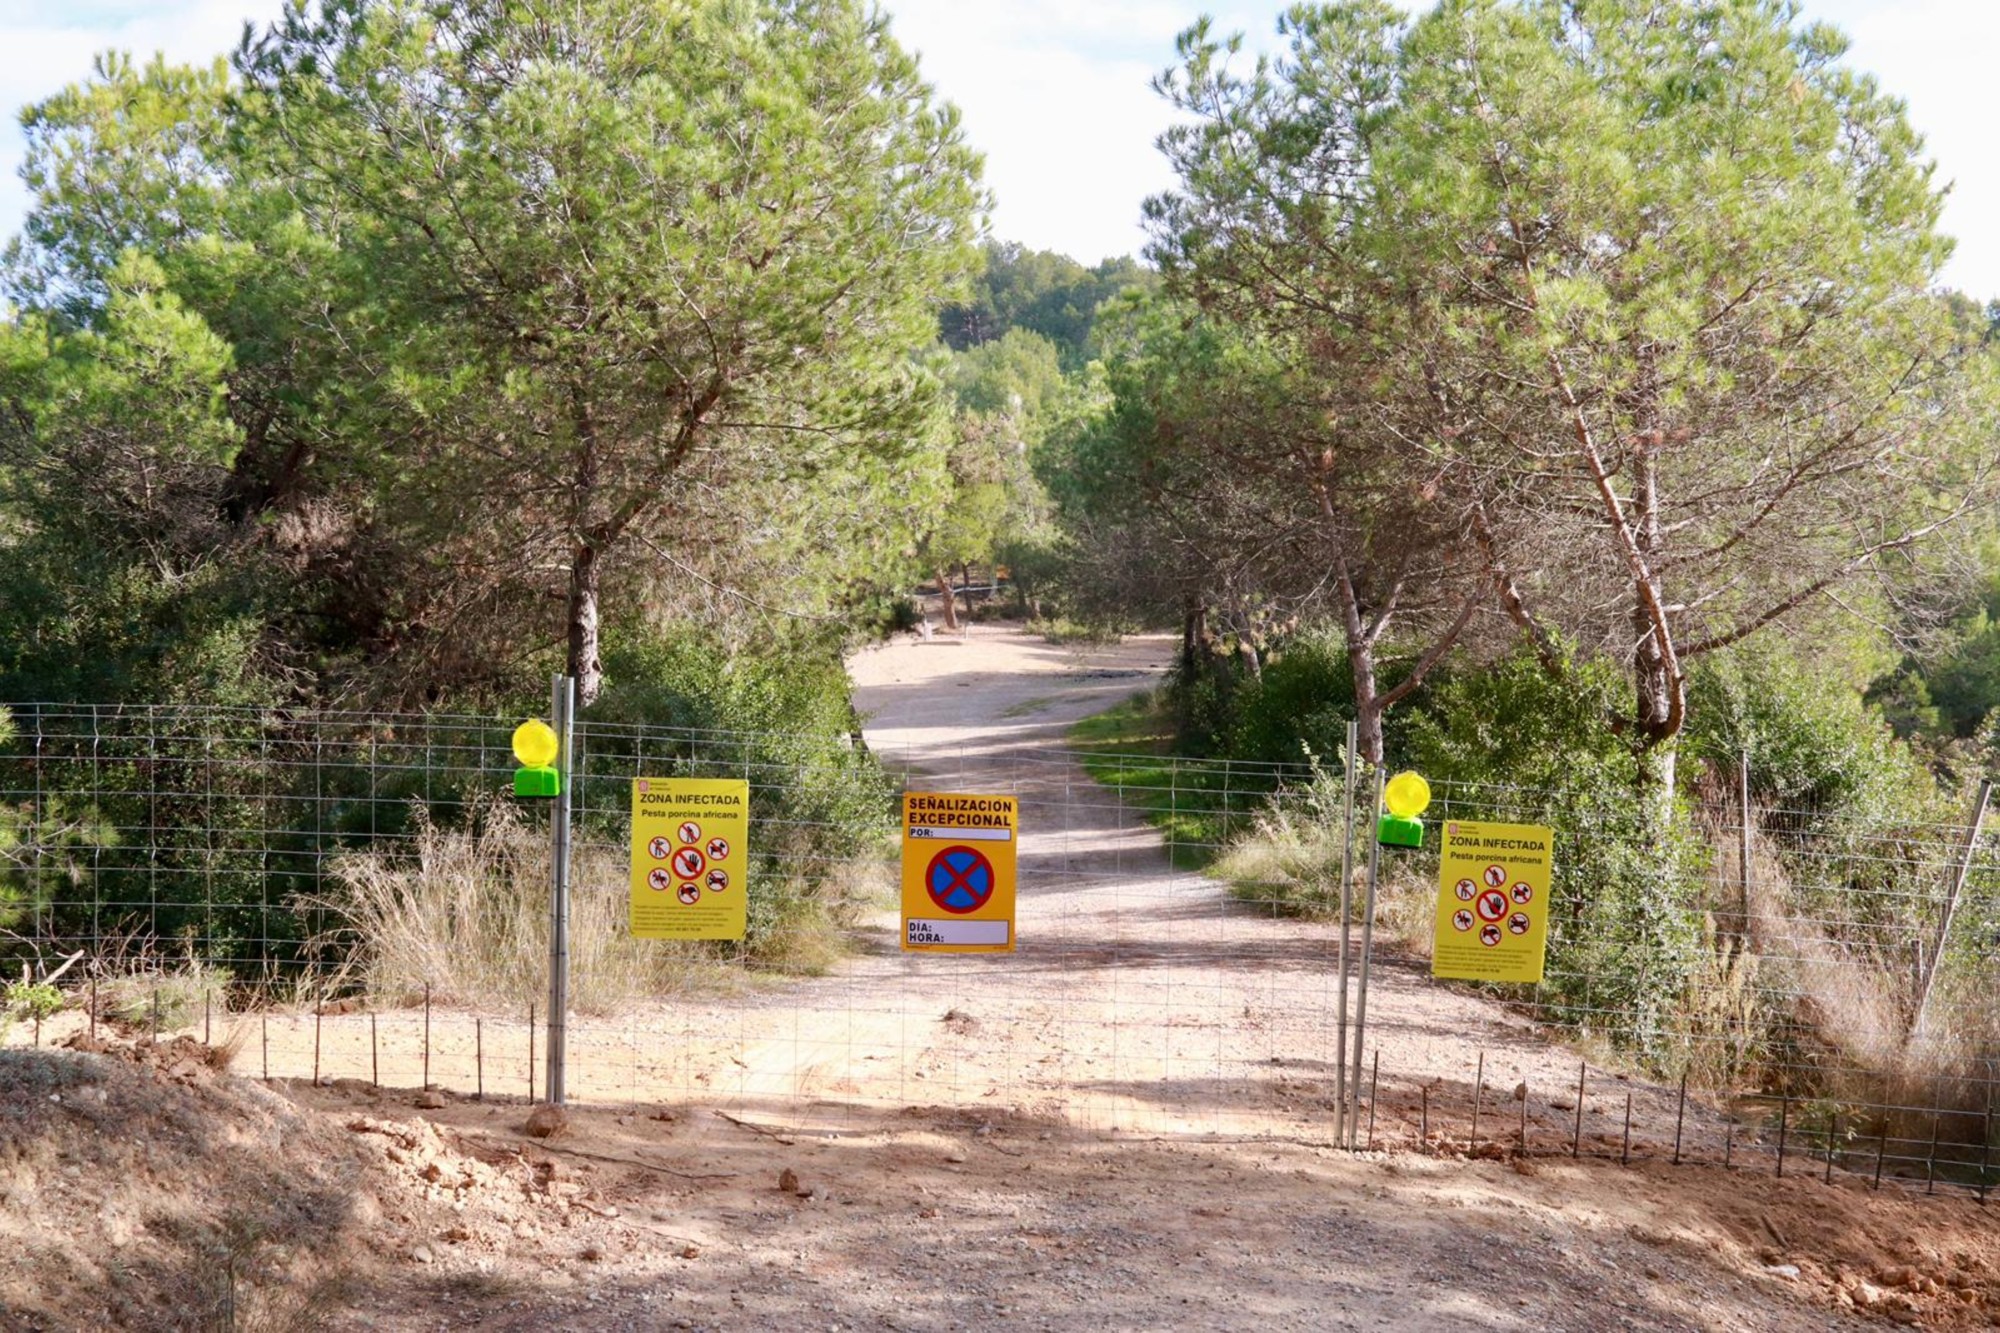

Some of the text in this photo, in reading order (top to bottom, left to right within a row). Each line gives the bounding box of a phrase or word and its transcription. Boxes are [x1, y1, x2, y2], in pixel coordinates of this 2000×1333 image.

[640, 794, 740, 805] ZONA INFECTADA
[909, 796, 1011, 812] SEÑALIZACIÓN
[668, 811, 700, 819] porcina
[909, 813, 1011, 826] EXCEPCIONAL
[910, 828, 933, 836] POR:
[1449, 836, 1545, 850] ZONA INFECTADA
[1450, 852, 1542, 864] Pesta porcina africana
[909, 920, 932, 932] DÍA:
[909, 933, 944, 942] HORA:
